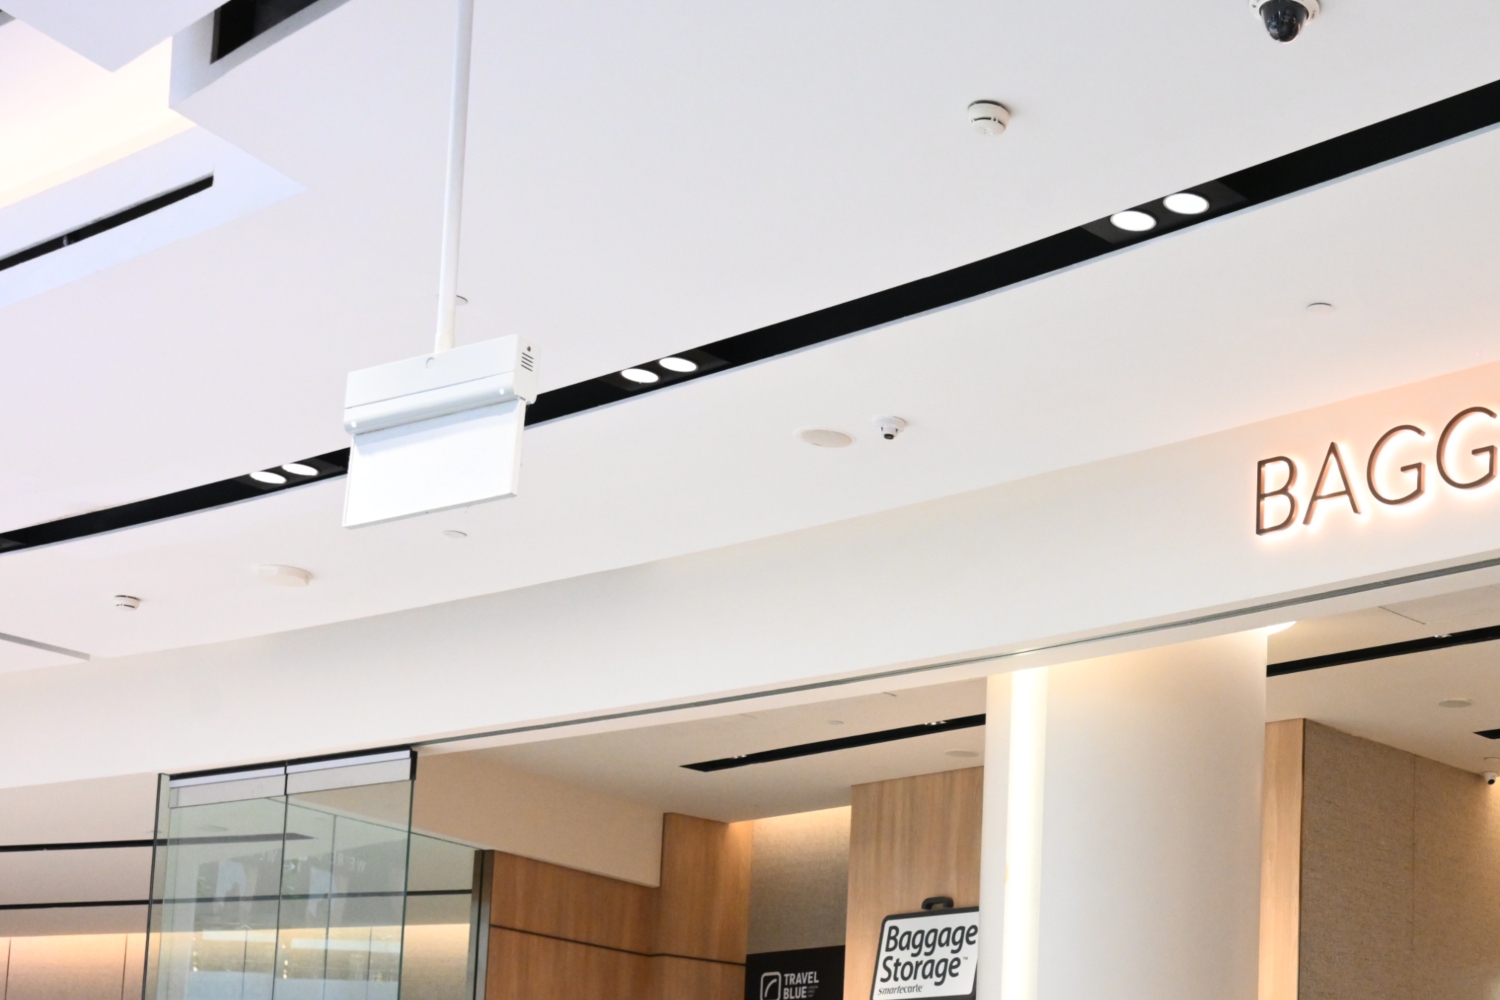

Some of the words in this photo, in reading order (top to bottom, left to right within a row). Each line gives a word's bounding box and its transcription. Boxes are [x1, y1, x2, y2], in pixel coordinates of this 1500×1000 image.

[884, 924, 978, 958] Baggage
[783, 971, 819, 986] TRAVEL
[880, 955, 961, 987] Storage
[783, 986, 807, 1000] BLUE
